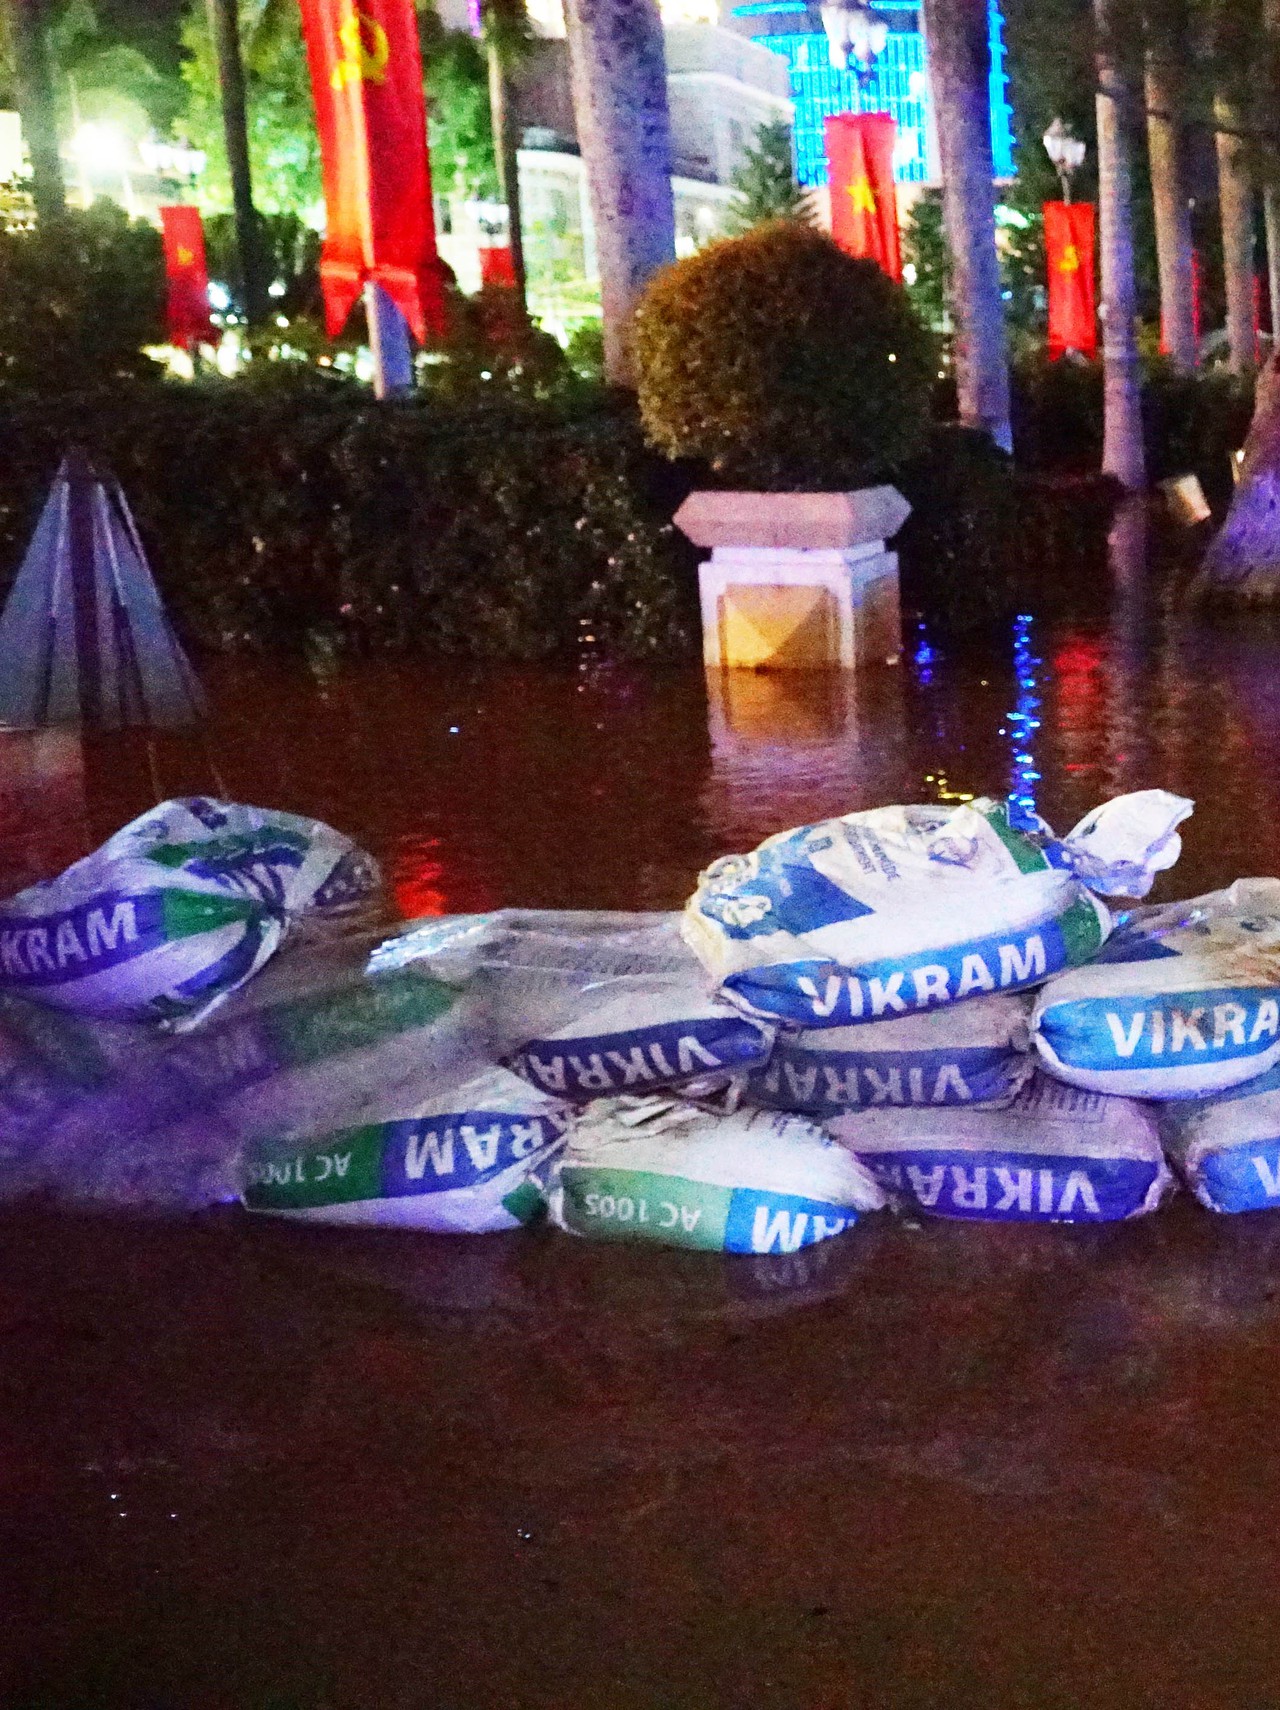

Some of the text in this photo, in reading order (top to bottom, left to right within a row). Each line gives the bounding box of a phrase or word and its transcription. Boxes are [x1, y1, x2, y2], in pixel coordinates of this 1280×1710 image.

[797, 935, 1047, 1017] VIKRAM
[521, 1035, 722, 1092] VIKRA
[765, 1061, 973, 1103] VIKRA
[315, 1150, 352, 1180] AC
[585, 1194, 857, 1254] AM AC 100S
